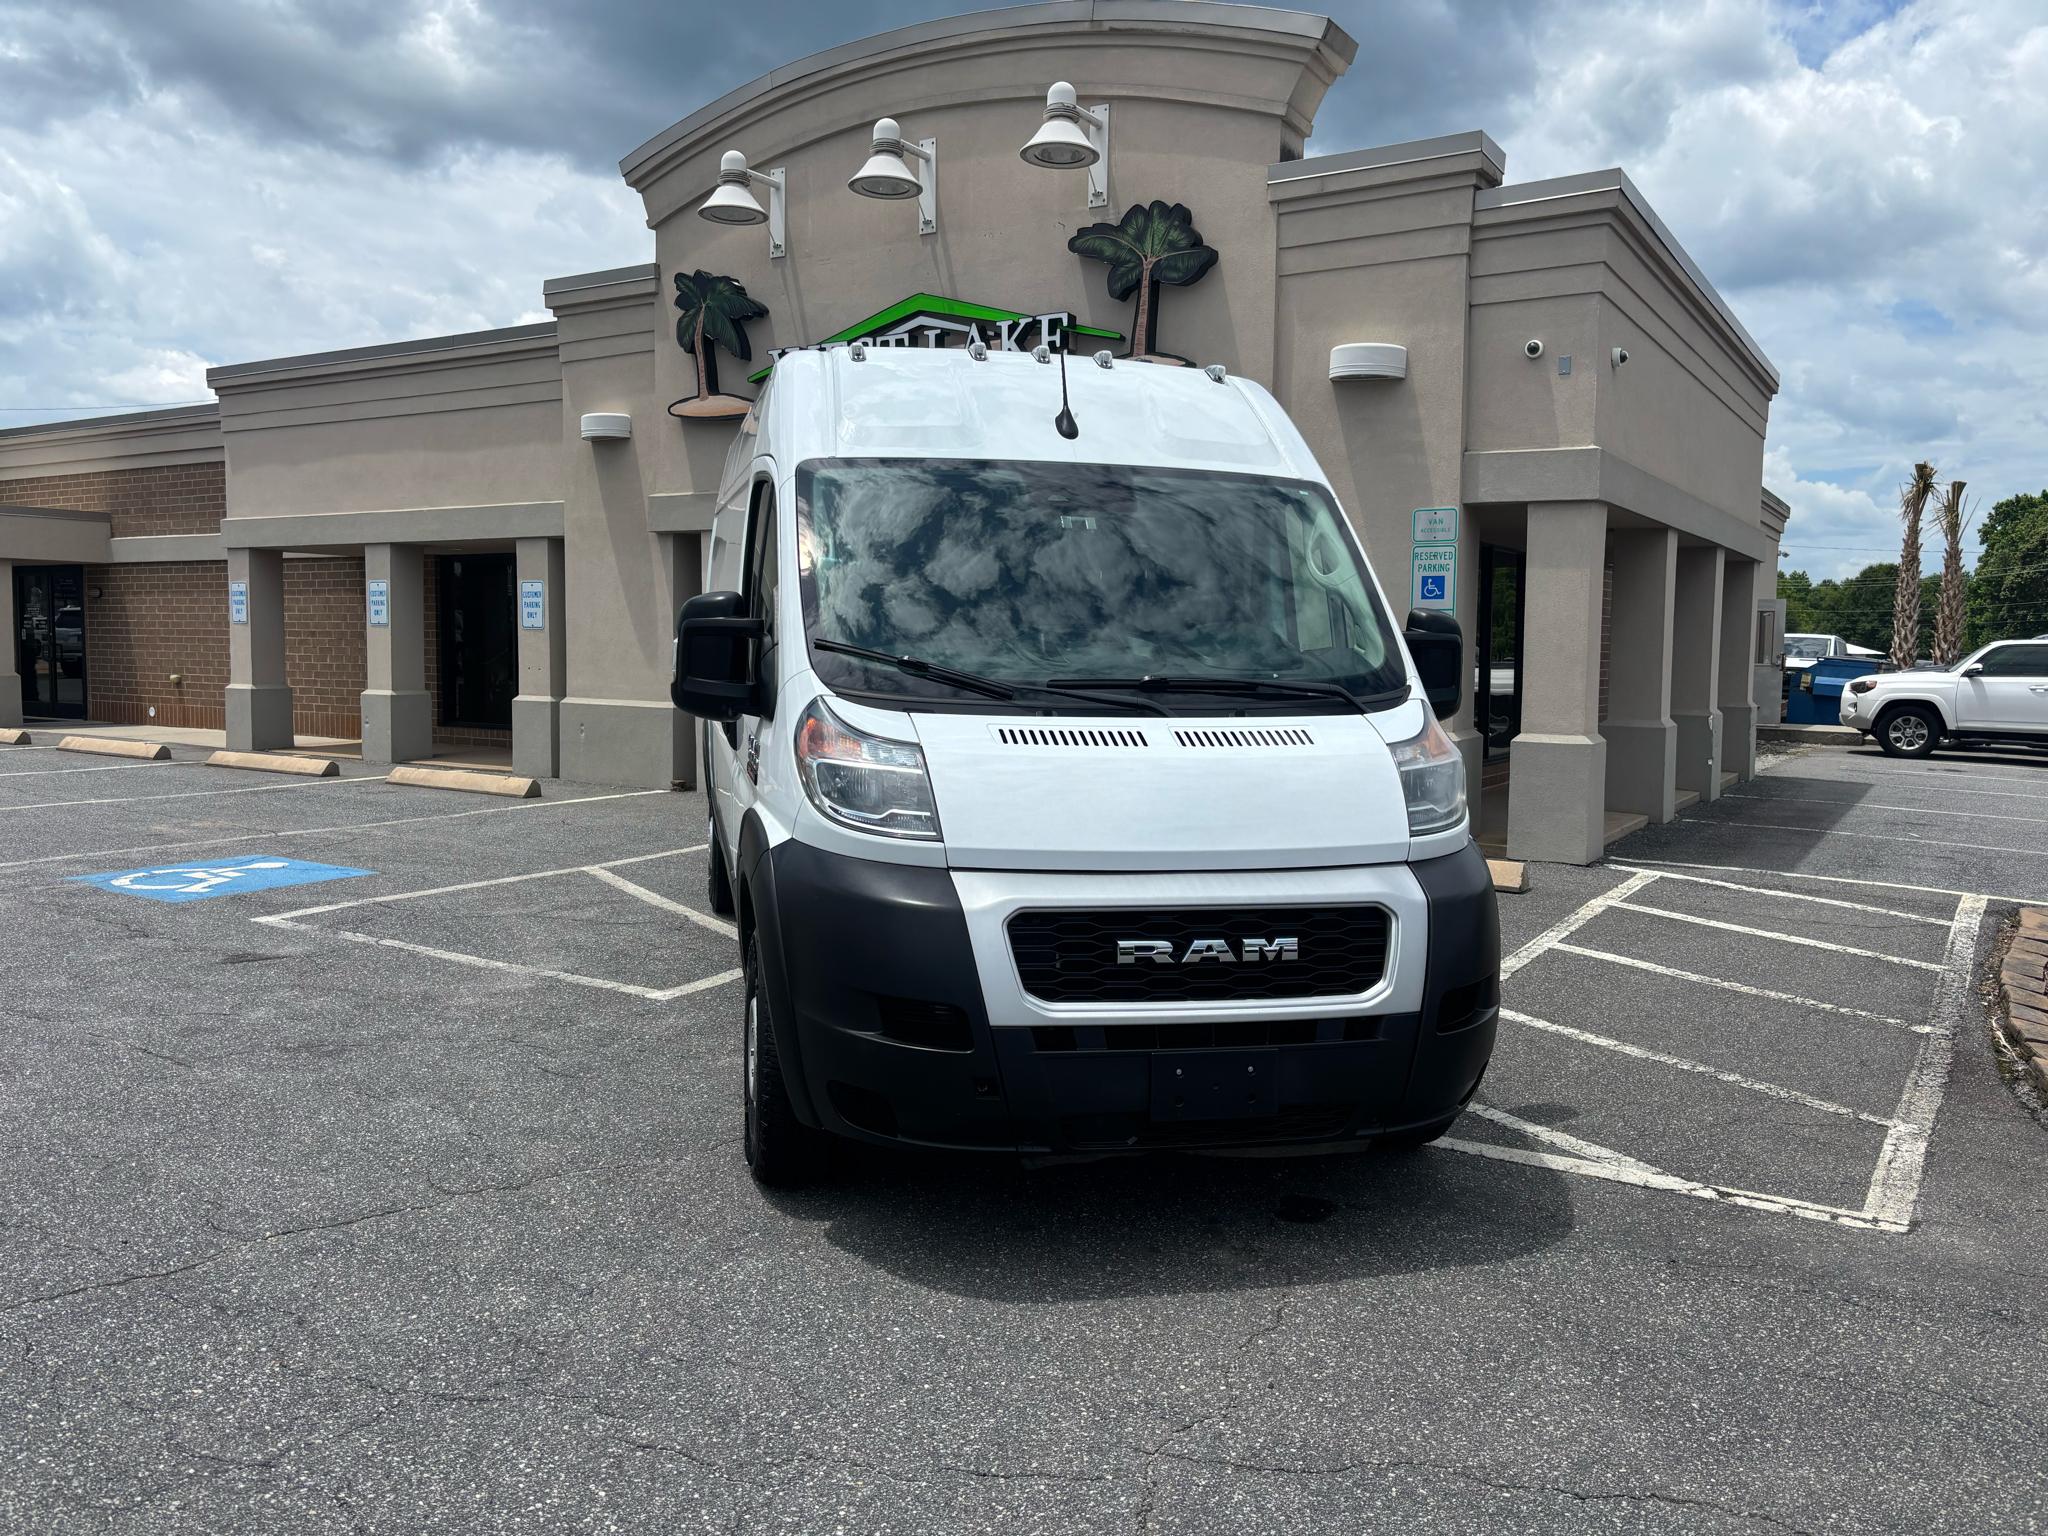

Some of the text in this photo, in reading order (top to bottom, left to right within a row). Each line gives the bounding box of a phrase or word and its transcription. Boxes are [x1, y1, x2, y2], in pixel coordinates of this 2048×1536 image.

[1428, 518, 1444, 526] VAN
[1414, 551, 1454, 561] RESERVED
[1417, 563, 1450, 573] PARKING
[1117, 937, 1299, 964] RAM
